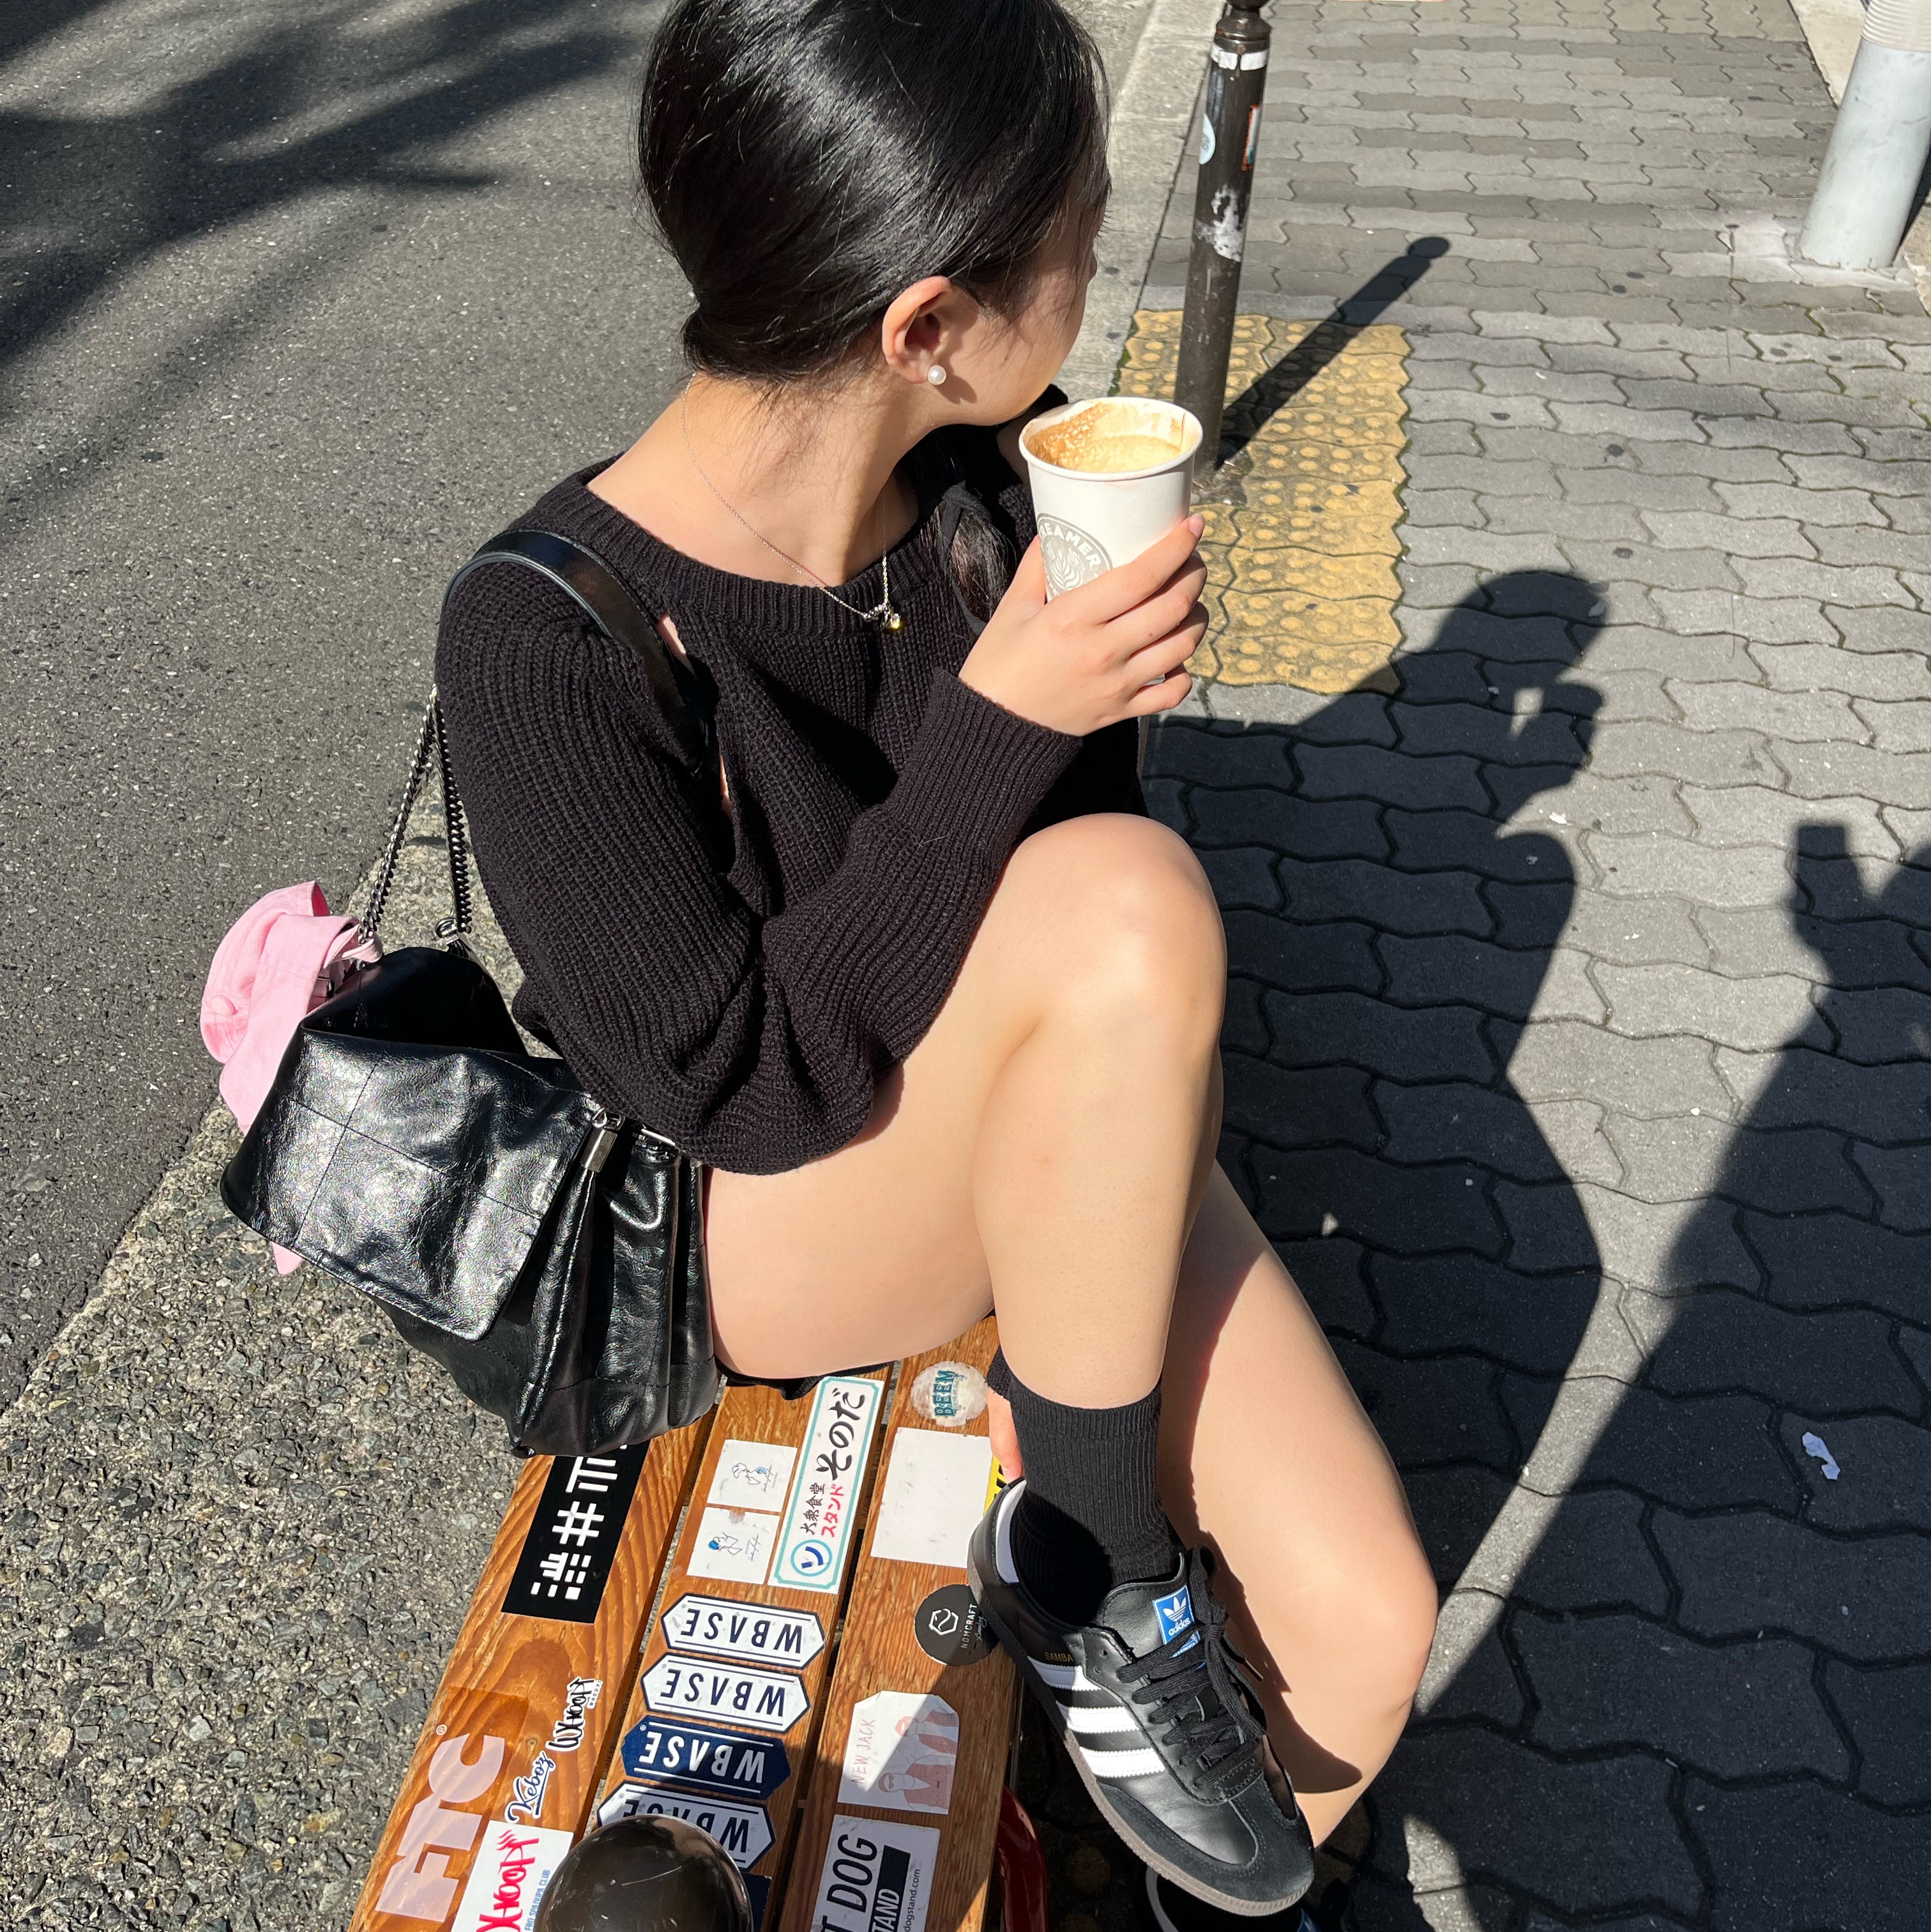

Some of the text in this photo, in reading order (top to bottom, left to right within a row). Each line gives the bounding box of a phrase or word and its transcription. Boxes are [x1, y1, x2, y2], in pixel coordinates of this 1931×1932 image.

[933, 1370, 957, 1417] BEEM
[815, 1387, 865, 1481] そのだ
[800, 1482, 826, 1535] 大衆食堂
[821, 1483, 844, 1537] スタンド
[680, 1608, 803, 1654] WBASE
[960, 1603, 978, 1649] NOMCRAFT
[1168, 1617, 1191, 1636] adidas
[1044, 1652, 1073, 1662] SAMBA
[660, 1668, 786, 1717] WBASE
[639, 1731, 766, 1784] WBASE
[851, 1718, 876, 1785] NEW JACK
[375, 1733, 505, 1923] FTC
[826, 1834, 877, 1913] DOG
